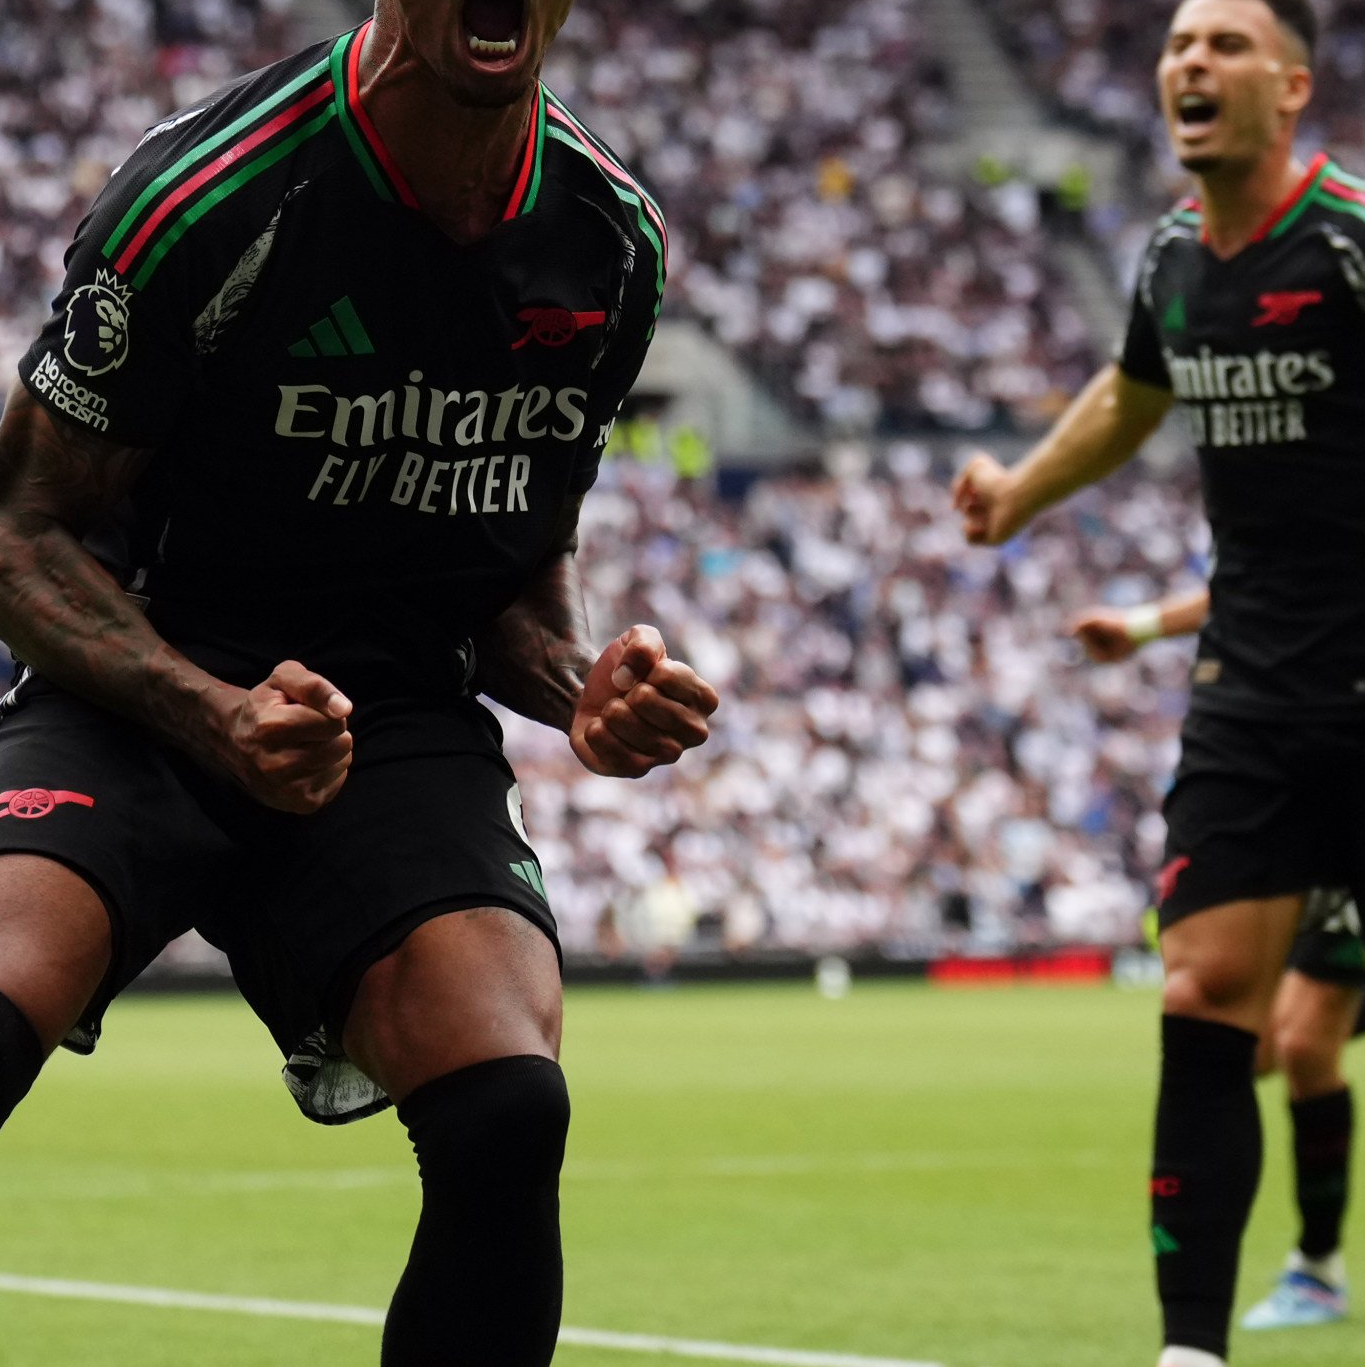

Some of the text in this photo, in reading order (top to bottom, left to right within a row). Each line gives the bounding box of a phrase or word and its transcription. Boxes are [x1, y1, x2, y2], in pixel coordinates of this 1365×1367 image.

[37, 351, 107, 413] No room
[1162, 343, 1336, 399] mirates
[48, 387, 109, 431] racism
[274, 370, 588, 447] Emirates
[307, 451, 530, 516] FLY BETTER
